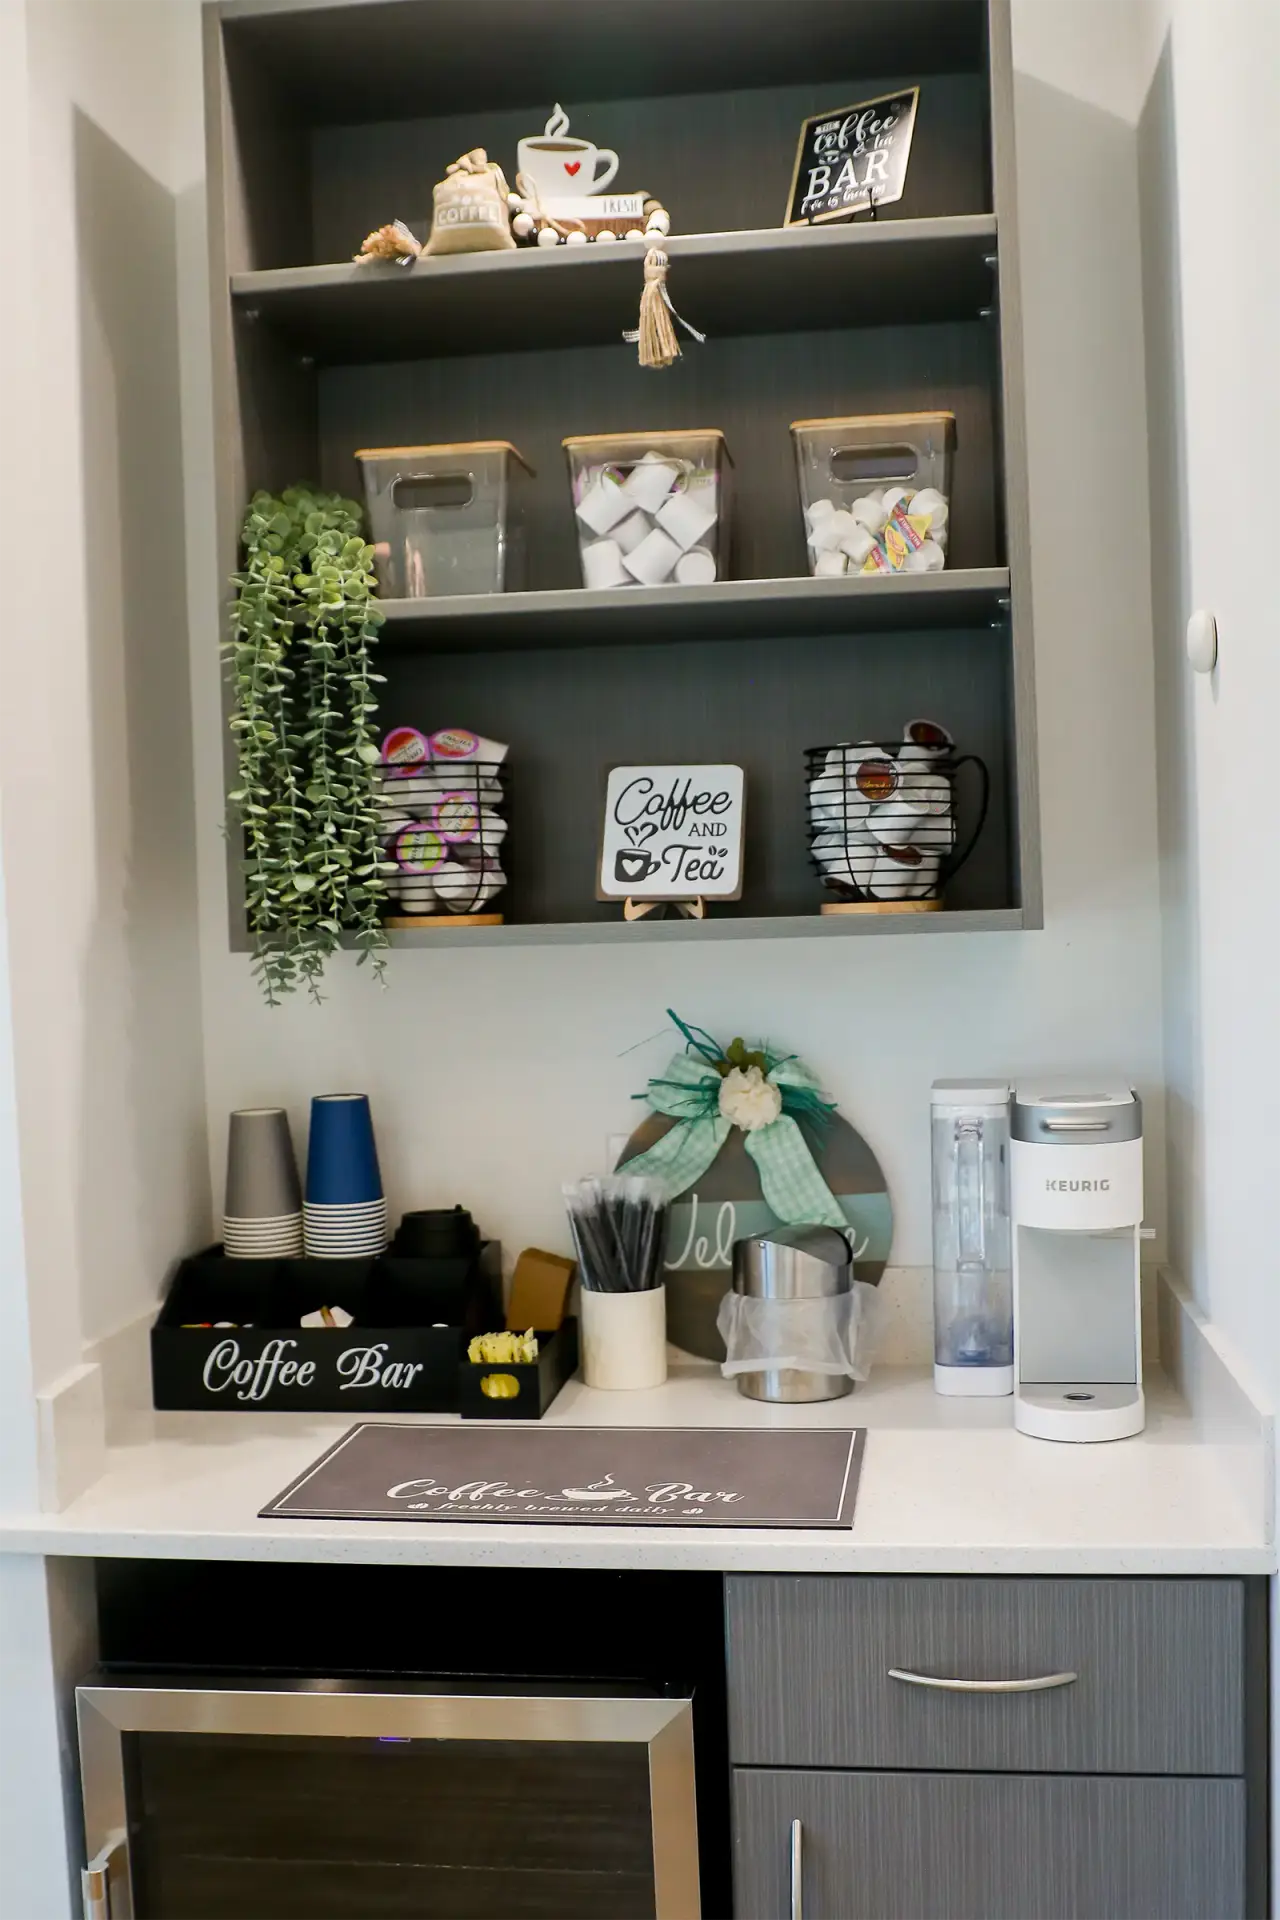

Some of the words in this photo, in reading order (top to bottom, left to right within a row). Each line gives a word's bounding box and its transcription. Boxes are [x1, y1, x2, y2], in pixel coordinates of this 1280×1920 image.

[803, 150, 889, 200] BAR
[614, 777, 733, 831] Coffee
[688, 822, 728, 837] AND
[661, 844, 725, 883] Tea
[1045, 1179, 1110, 1192] KEURIG
[202, 1338, 318, 1401] Coffee
[336, 1342, 424, 1391] Bar
[386, 1478, 546, 1501] Coffee
[644, 1482, 745, 1503] Bar
[433, 1502, 518, 1512] freshly
[524, 1504, 609, 1513] brewed
[615, 1505, 676, 1515] daily
